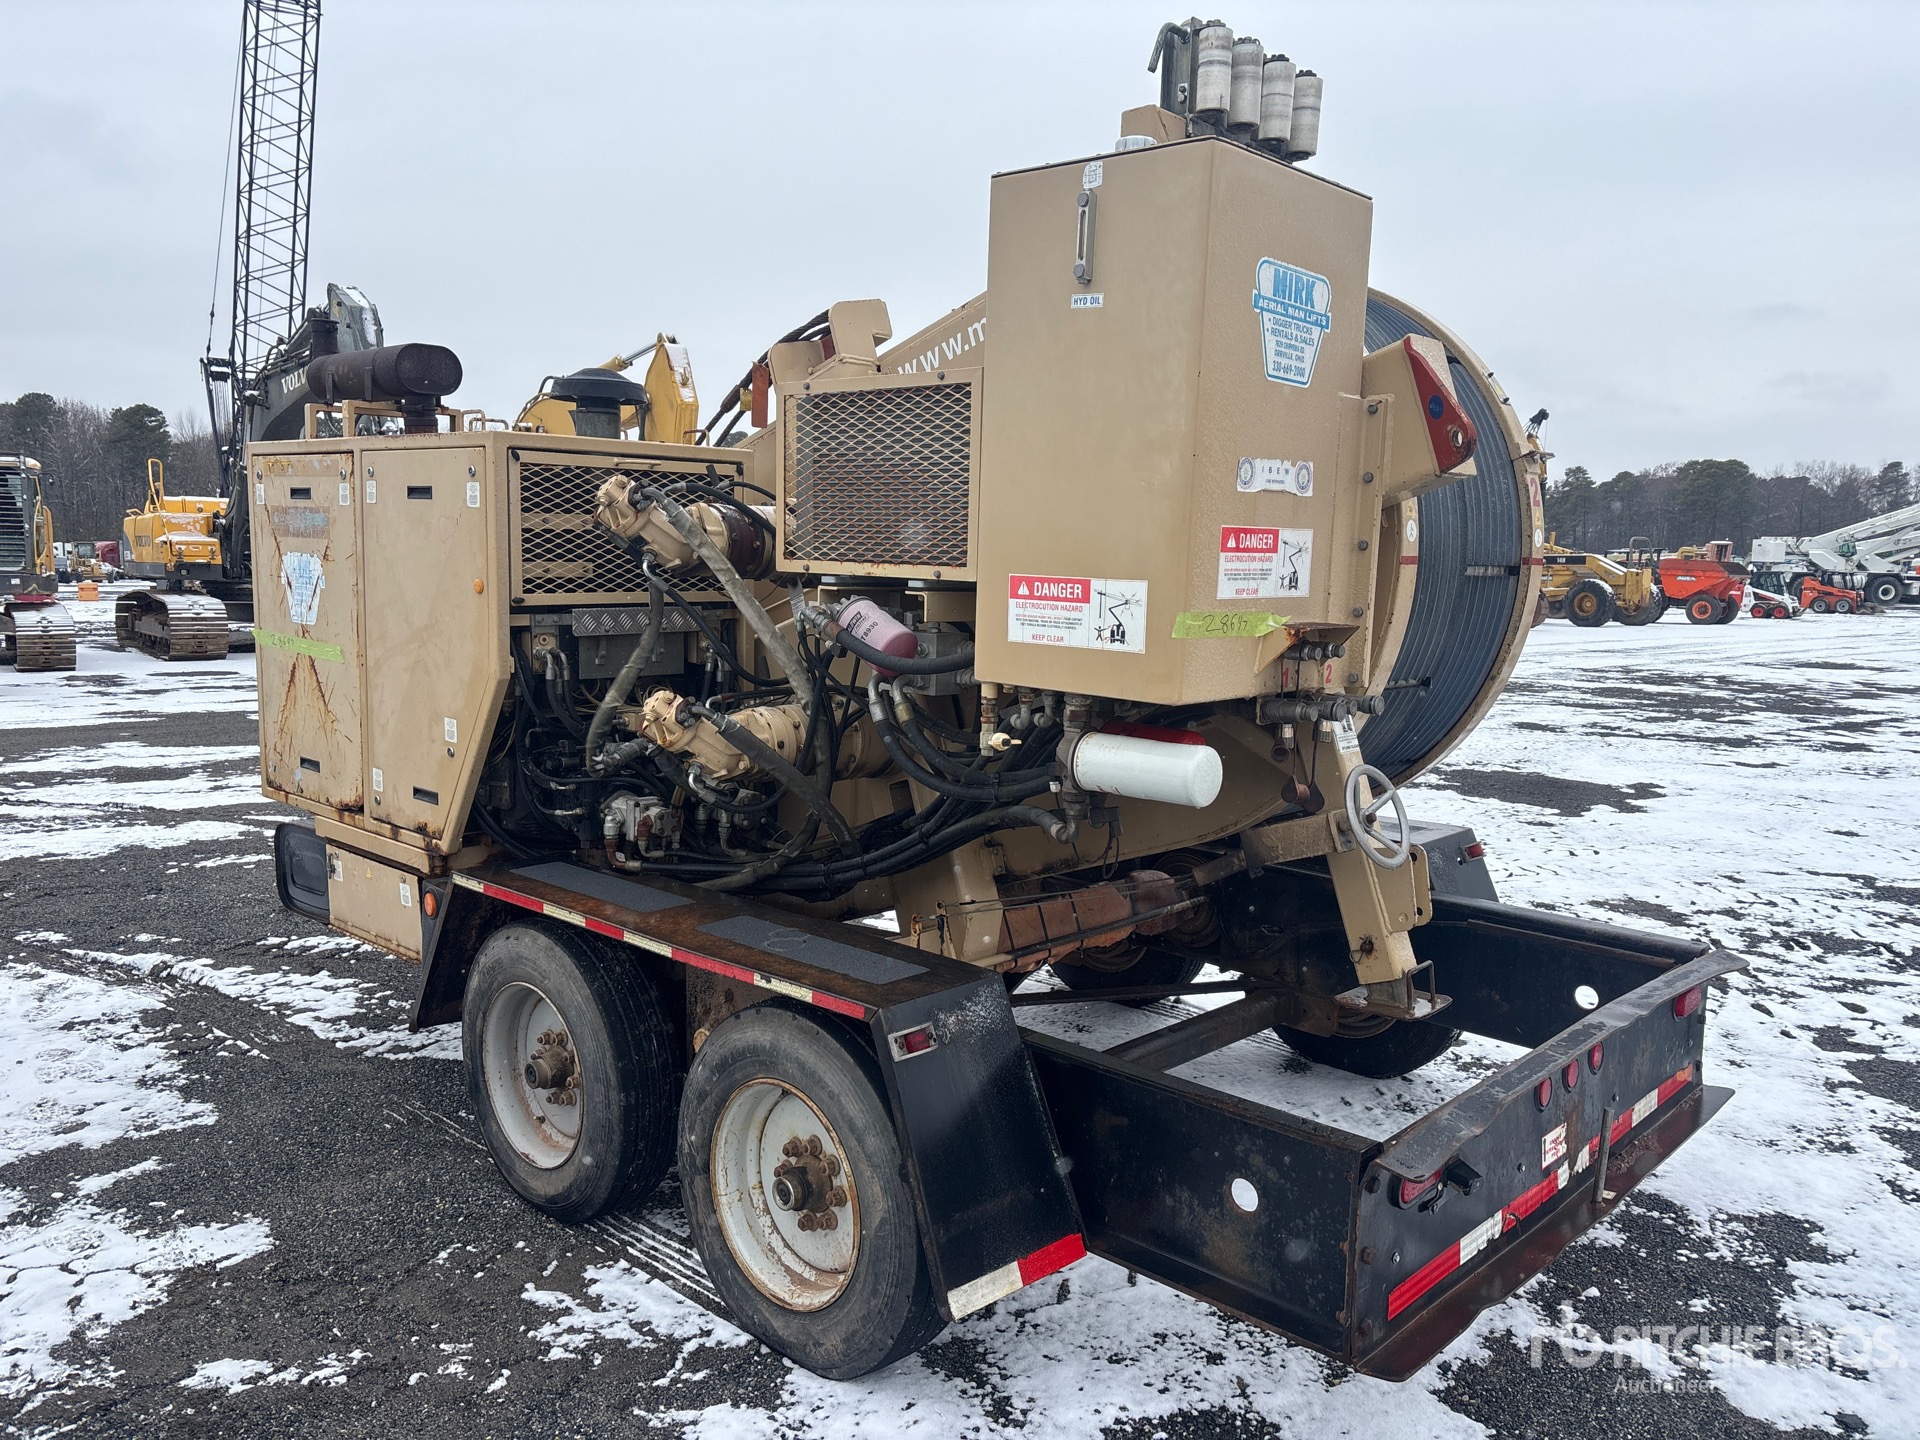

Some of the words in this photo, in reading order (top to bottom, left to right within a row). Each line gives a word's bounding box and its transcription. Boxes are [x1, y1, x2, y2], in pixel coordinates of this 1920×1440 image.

[1273, 268, 1317, 310] MIRK
[1073, 297, 1087, 306] HYD
[1089, 295, 1101, 305] OIL
[1258, 298, 1287, 314] AERIAL
[1287, 306, 1304, 320] MAN
[1306, 311, 1327, 326] LIFTS
[1272, 316, 1293, 331] DIGGER
[1292, 321, 1313, 336] TRUCKS
[1270, 327, 1294, 341] RENTALS
[1299, 334, 1315, 347] SALES
[281, 365, 309, 394] VOLV
[1530, 477, 1541, 507] 2
[134, 535, 151, 547] VOLVO
[1239, 533, 1274, 549] DANGER
[1224, 555, 1257, 563] ELECTROCUTION
[1033, 581, 1083, 599] DANGER
[1234, 588, 1246, 596] KEEP
[1245, 588, 1259, 596] CLEAR
[1015, 601, 1059, 611] ELECTROCUTION
[1060, 604, 1083, 613] HAZARD
[1031, 633, 1046, 641] KEEP
[1046, 634, 1064, 642] CLEAR
[1325, 663, 1333, 684] 2
